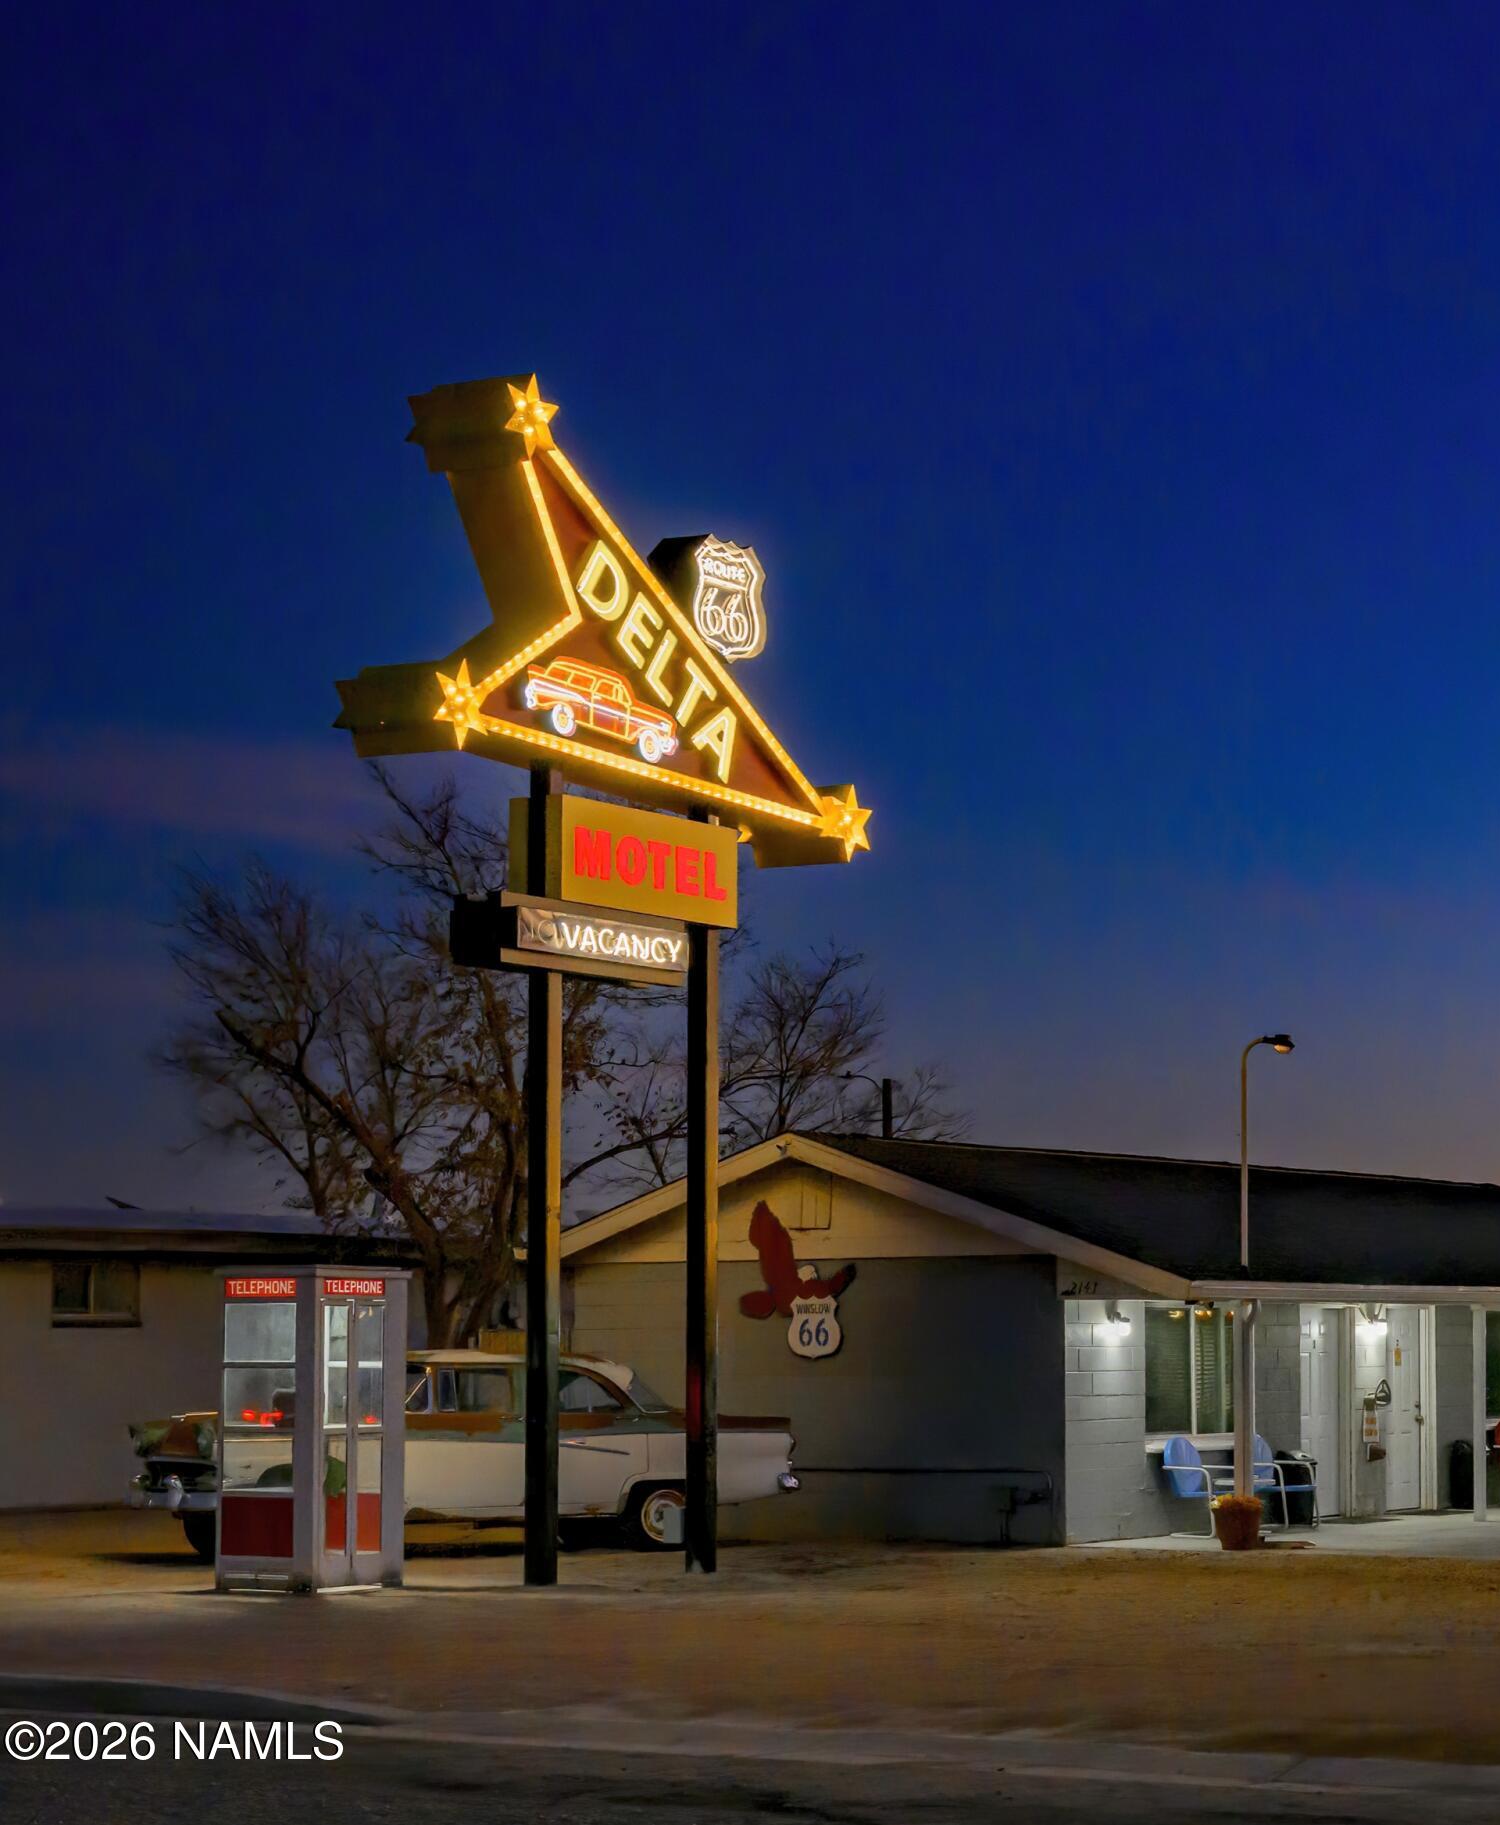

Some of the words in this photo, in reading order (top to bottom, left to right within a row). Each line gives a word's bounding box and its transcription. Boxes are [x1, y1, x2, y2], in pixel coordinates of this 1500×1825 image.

[702, 558, 747, 581] ROUTE
[702, 587, 749, 643] 66
[576, 540, 737, 784] DELTA
[574, 825, 728, 902] MOTEL
[561, 922, 682, 963] VACANCY
[228, 1280, 296, 1295] TELEPHONE
[326, 1279, 383, 1294] TELEPHONE
[796, 1303, 831, 1314] WINSLOW
[799, 1318, 829, 1347] 66
